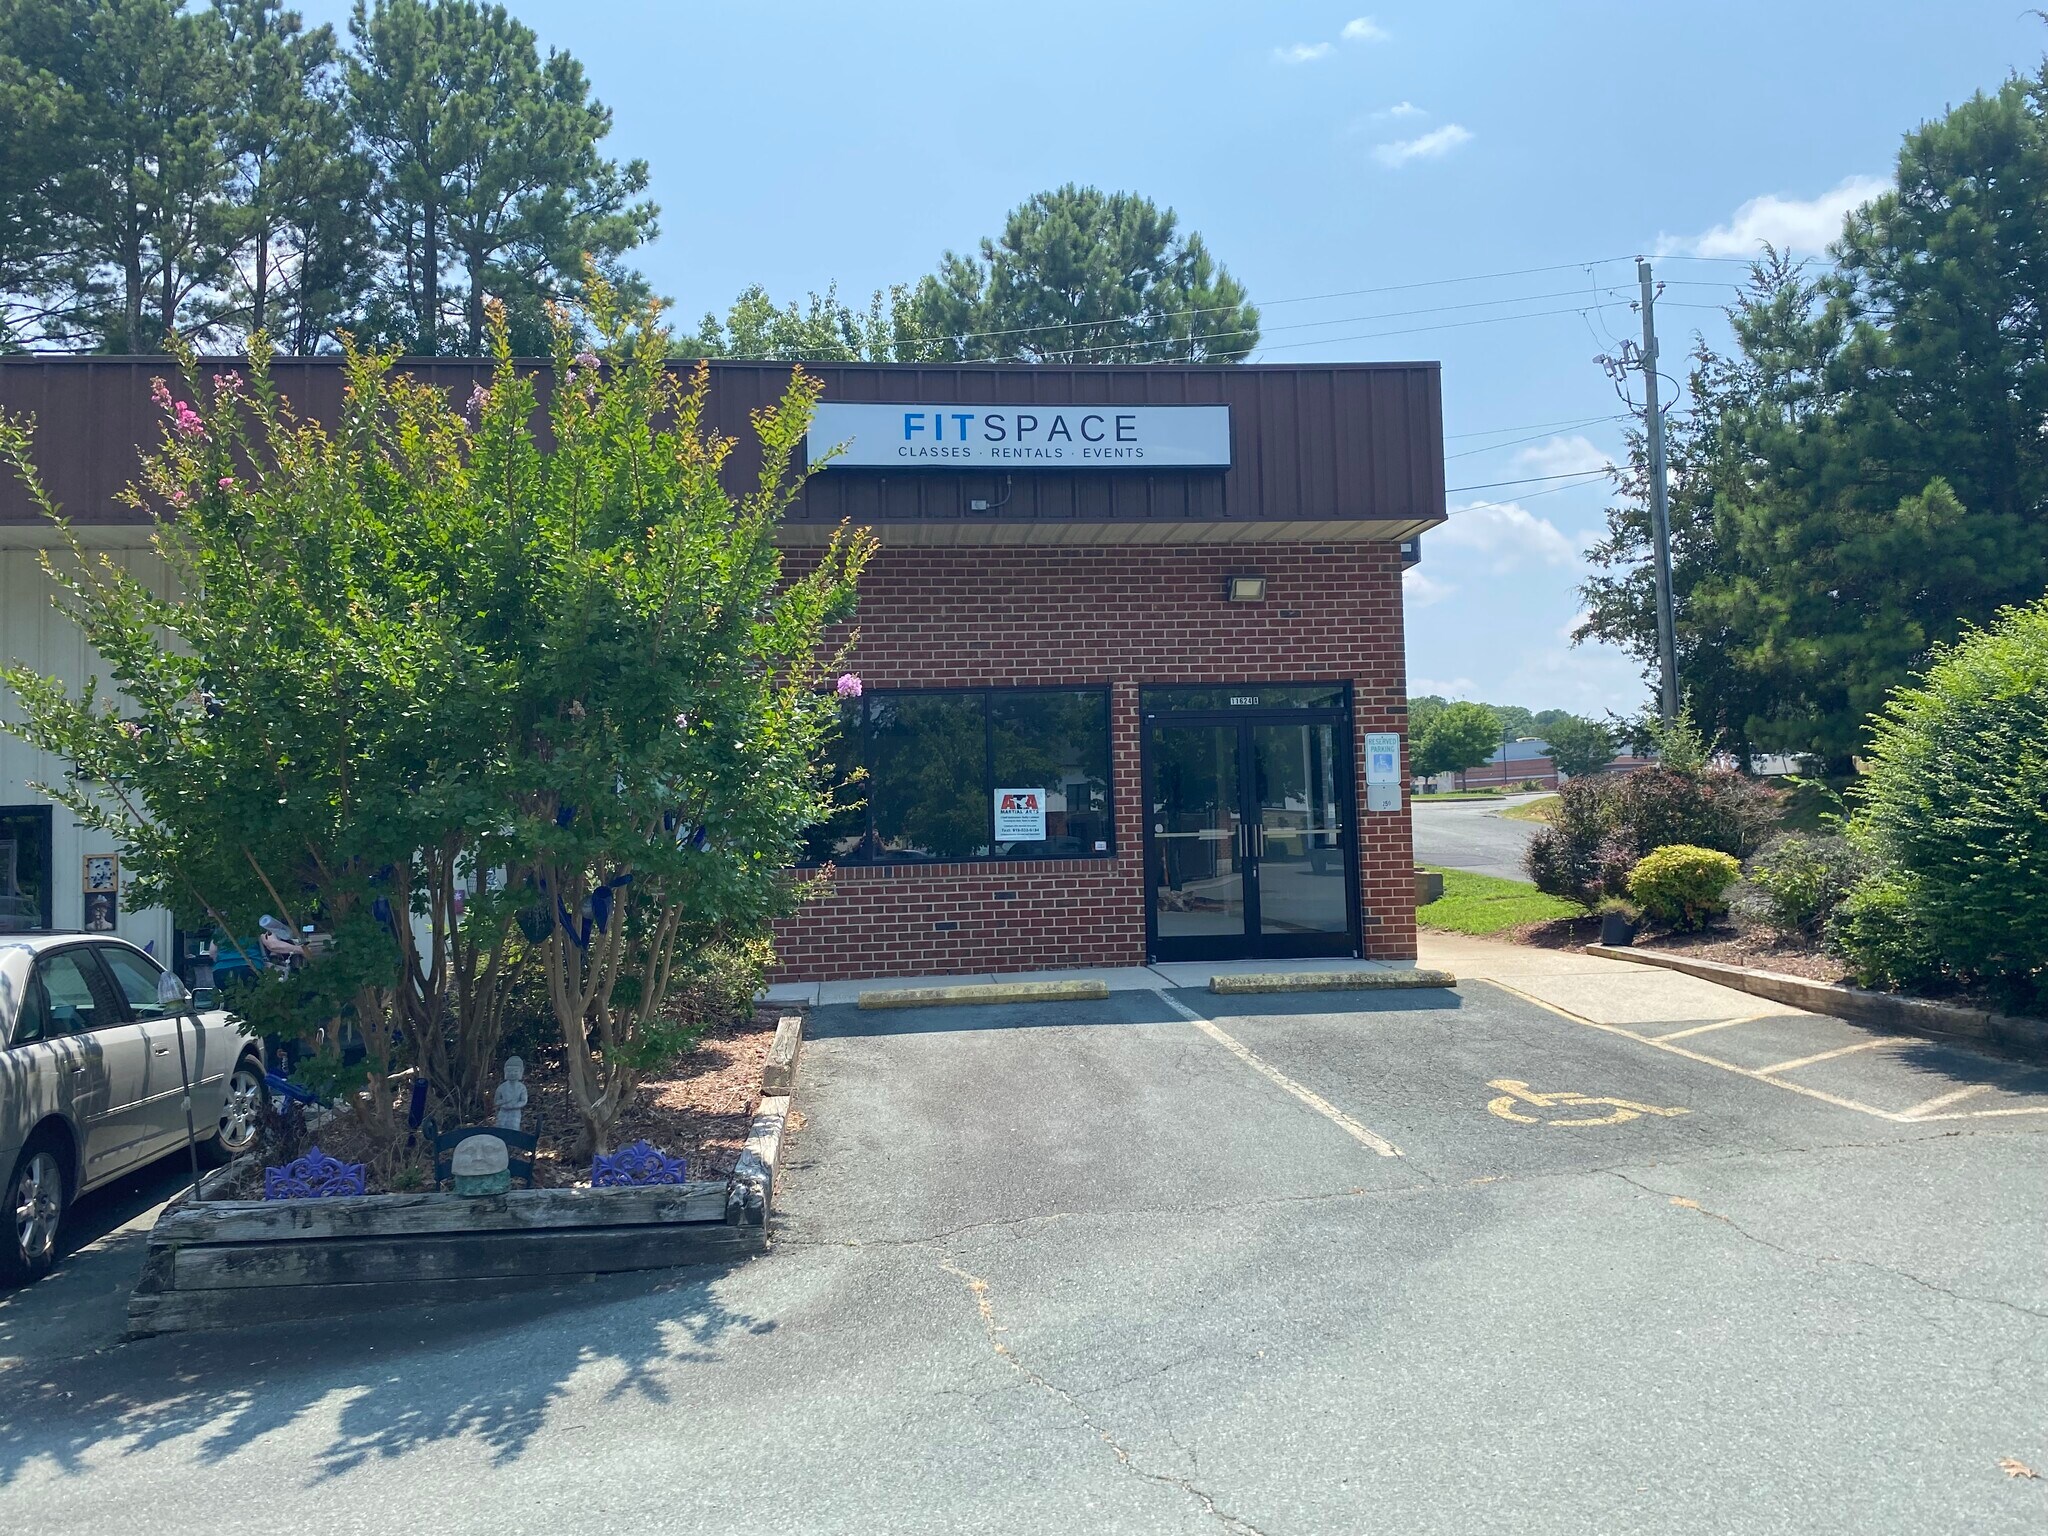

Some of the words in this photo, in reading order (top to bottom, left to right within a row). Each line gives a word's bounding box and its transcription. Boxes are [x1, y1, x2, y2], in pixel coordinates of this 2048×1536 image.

[904, 413, 1138, 442] FITSPACE
[898, 446, 971, 458] CLASSES
[991, 447, 1063, 458] RENTALS
[1083, 447, 1144, 458] EVENTS
[1368, 738, 1397, 746] RESERVED
[1370, 745, 1395, 753] PARKING
[1001, 794, 1039, 809] ATA
